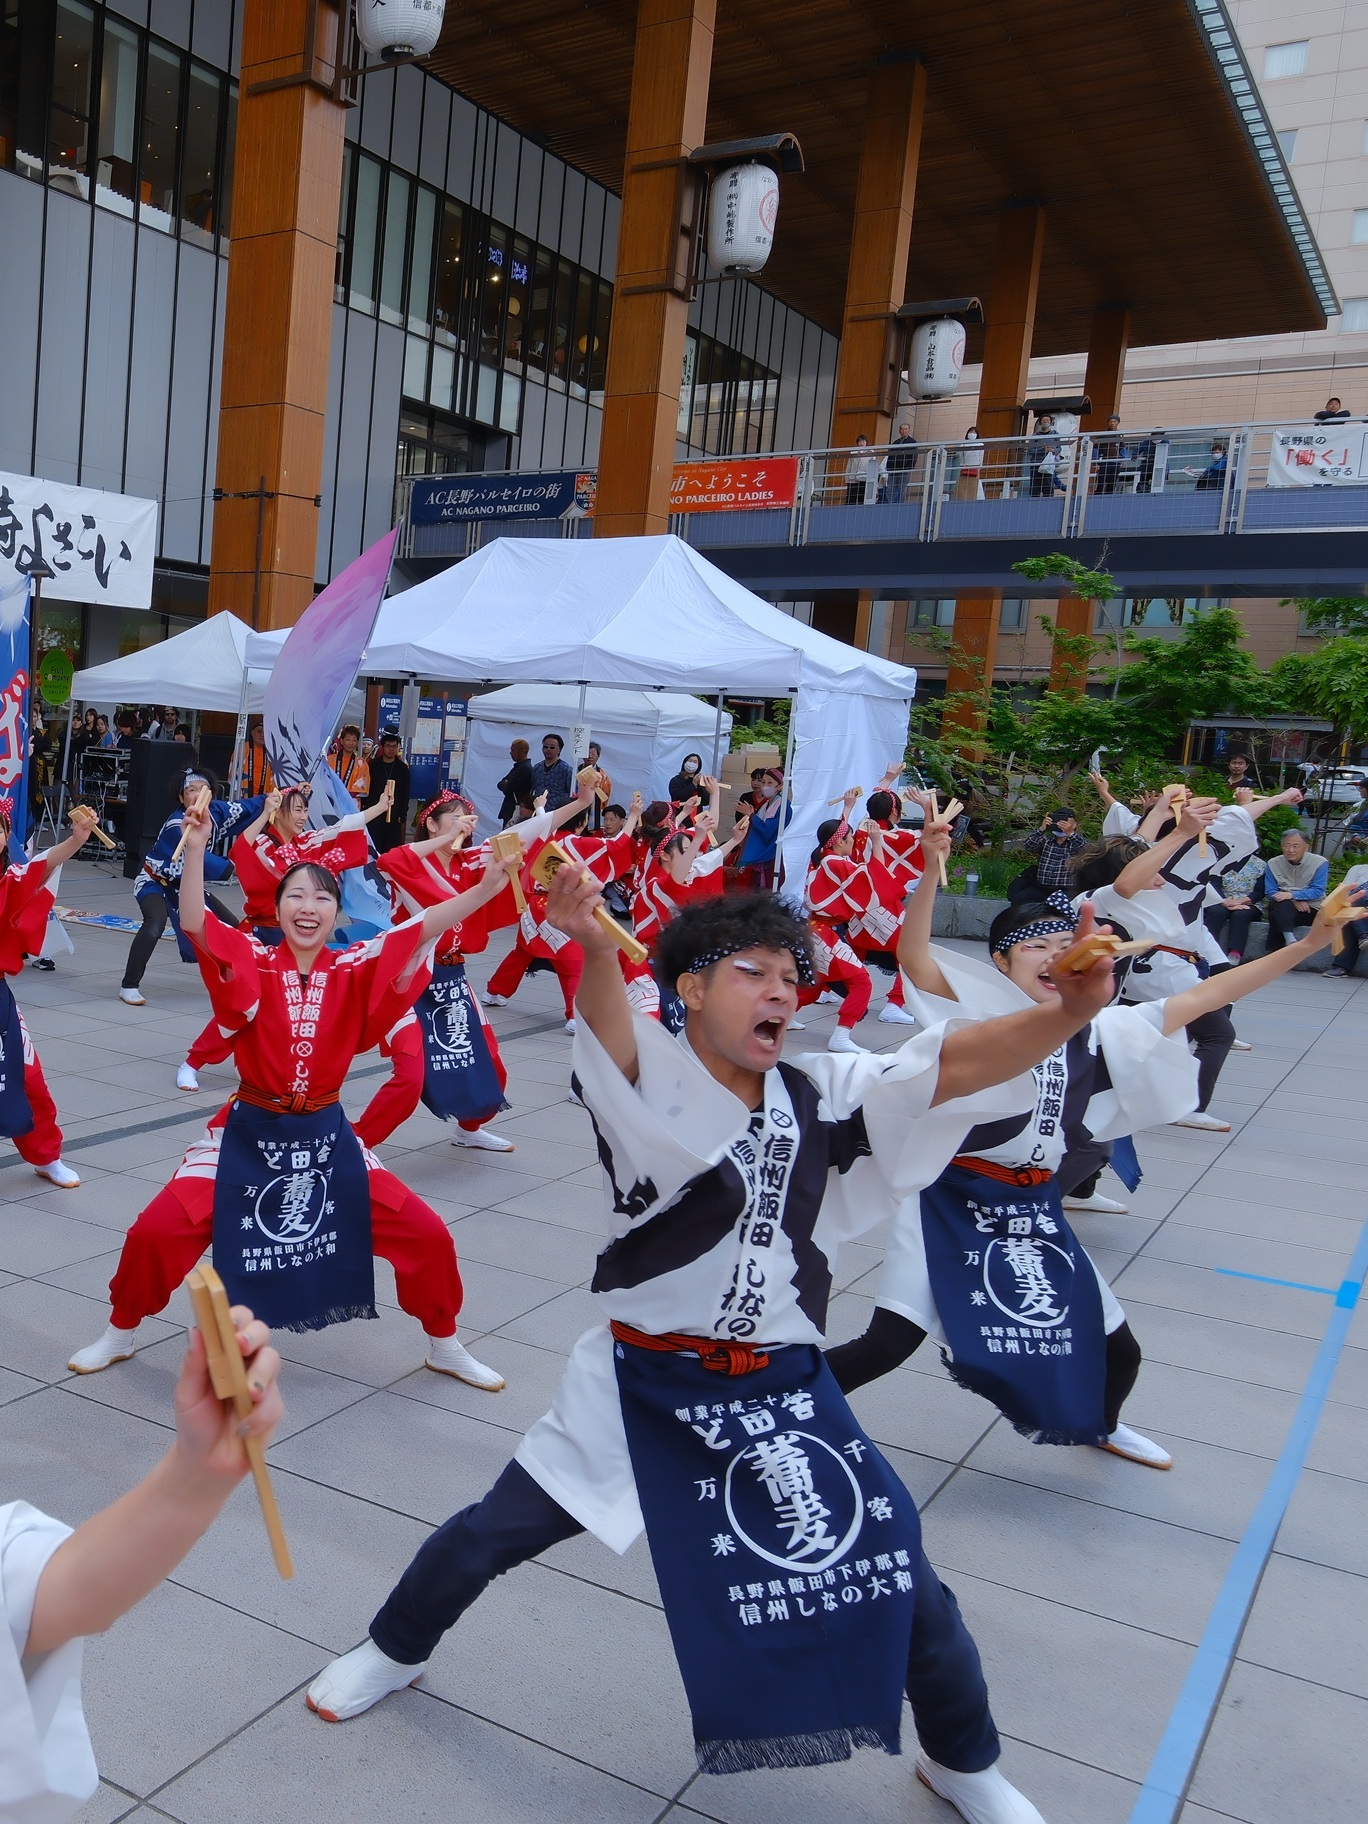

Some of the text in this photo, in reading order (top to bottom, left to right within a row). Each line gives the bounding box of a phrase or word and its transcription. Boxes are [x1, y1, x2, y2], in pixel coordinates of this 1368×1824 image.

[1280, 436, 1327, 446] 長野県の
[425, 482, 562, 506] AC長野パルセイロの街
[685, 493, 735, 504] PARCEIRO
[738, 490, 774, 501] LADIES
[1319, 467, 1353, 477] を守る
[441, 502, 540, 516] AC NAGANO PARCEIRO
[292, 970, 328, 1096] 信州飯田 しな
[445, 1000, 471, 1048] 蕎麦
[1038, 1059, 1065, 1137] 信州飯田
[263, 1144, 332, 1170] ど田舎
[240, 1184, 259, 1231] 万来
[277, 1171, 316, 1237] 蕎麦
[750, 1133, 795, 1248] 信州飯田
[241, 1231, 338, 1258] 長野県飯田市下伊那郡
[974, 1211, 1059, 1235] ど田舎
[245, 1243, 336, 1272] 信州しなの大和
[964, 1251, 987, 1307] 万来
[996, 1237, 1060, 1318] 蕎麦
[728, 1258, 766, 1337] しなの
[691, 1391, 815, 1450] ど田舎
[743, 1433, 837, 1560] 蕎麦
[843, 1438, 893, 1522] 千客
[693, 1477, 737, 1557] 万来
[727, 1549, 911, 1602] 長野県飯田市下伊那郡
[739, 1570, 913, 1626] 信州しなの大和
